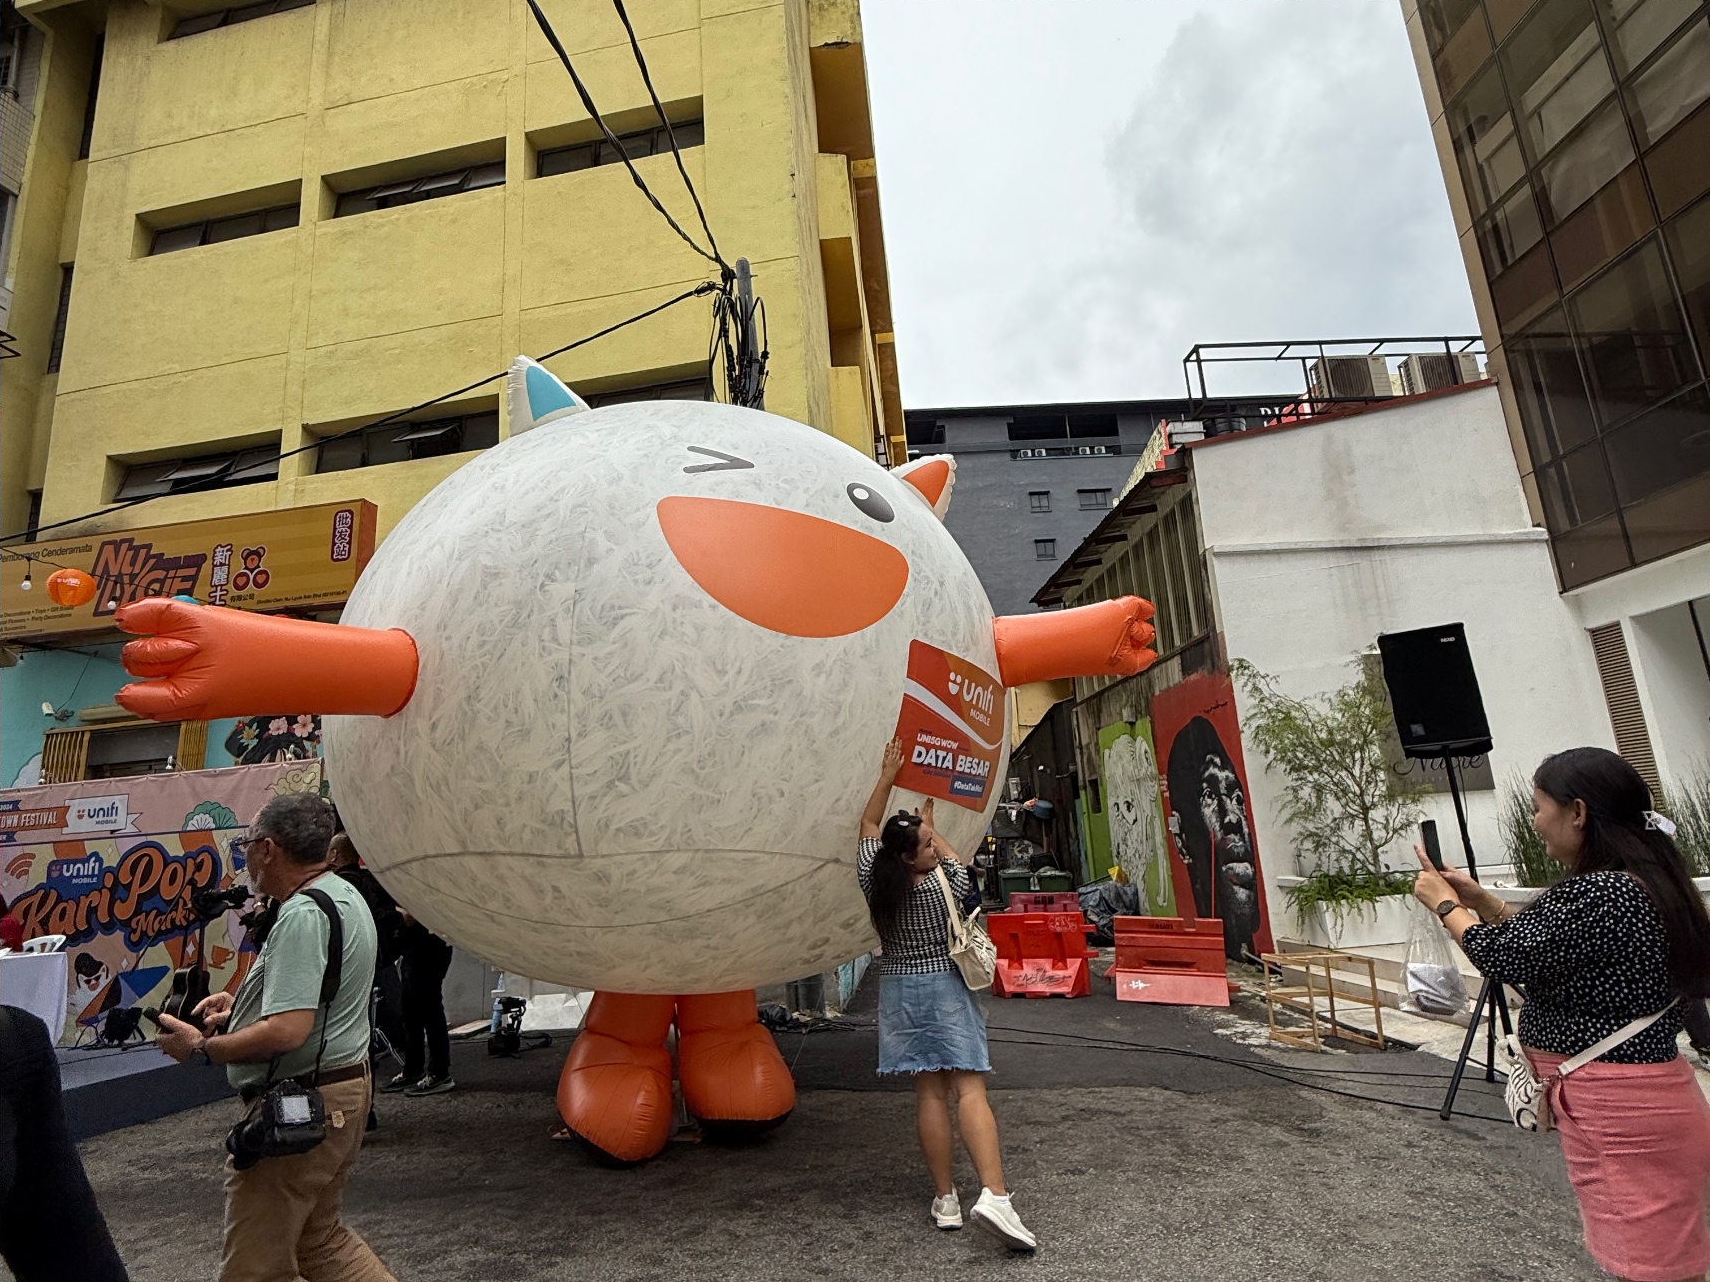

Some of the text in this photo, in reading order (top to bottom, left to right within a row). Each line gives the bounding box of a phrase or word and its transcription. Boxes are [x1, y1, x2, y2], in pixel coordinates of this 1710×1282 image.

[333, 512, 351, 559] 批发站
[41, 544, 93, 558] Cenderamata
[963, 679, 994, 714] unifi
[970, 708, 990, 727] MOBILE
[911, 745, 990, 777] DATA BESAR
[20, 812, 57, 826] FESTIVAL
[87, 801, 119, 819] unifi
[62, 856, 99, 877] unifi
[71, 877, 97, 885] MOBILE
[12, 848, 212, 938] Kari Pop
